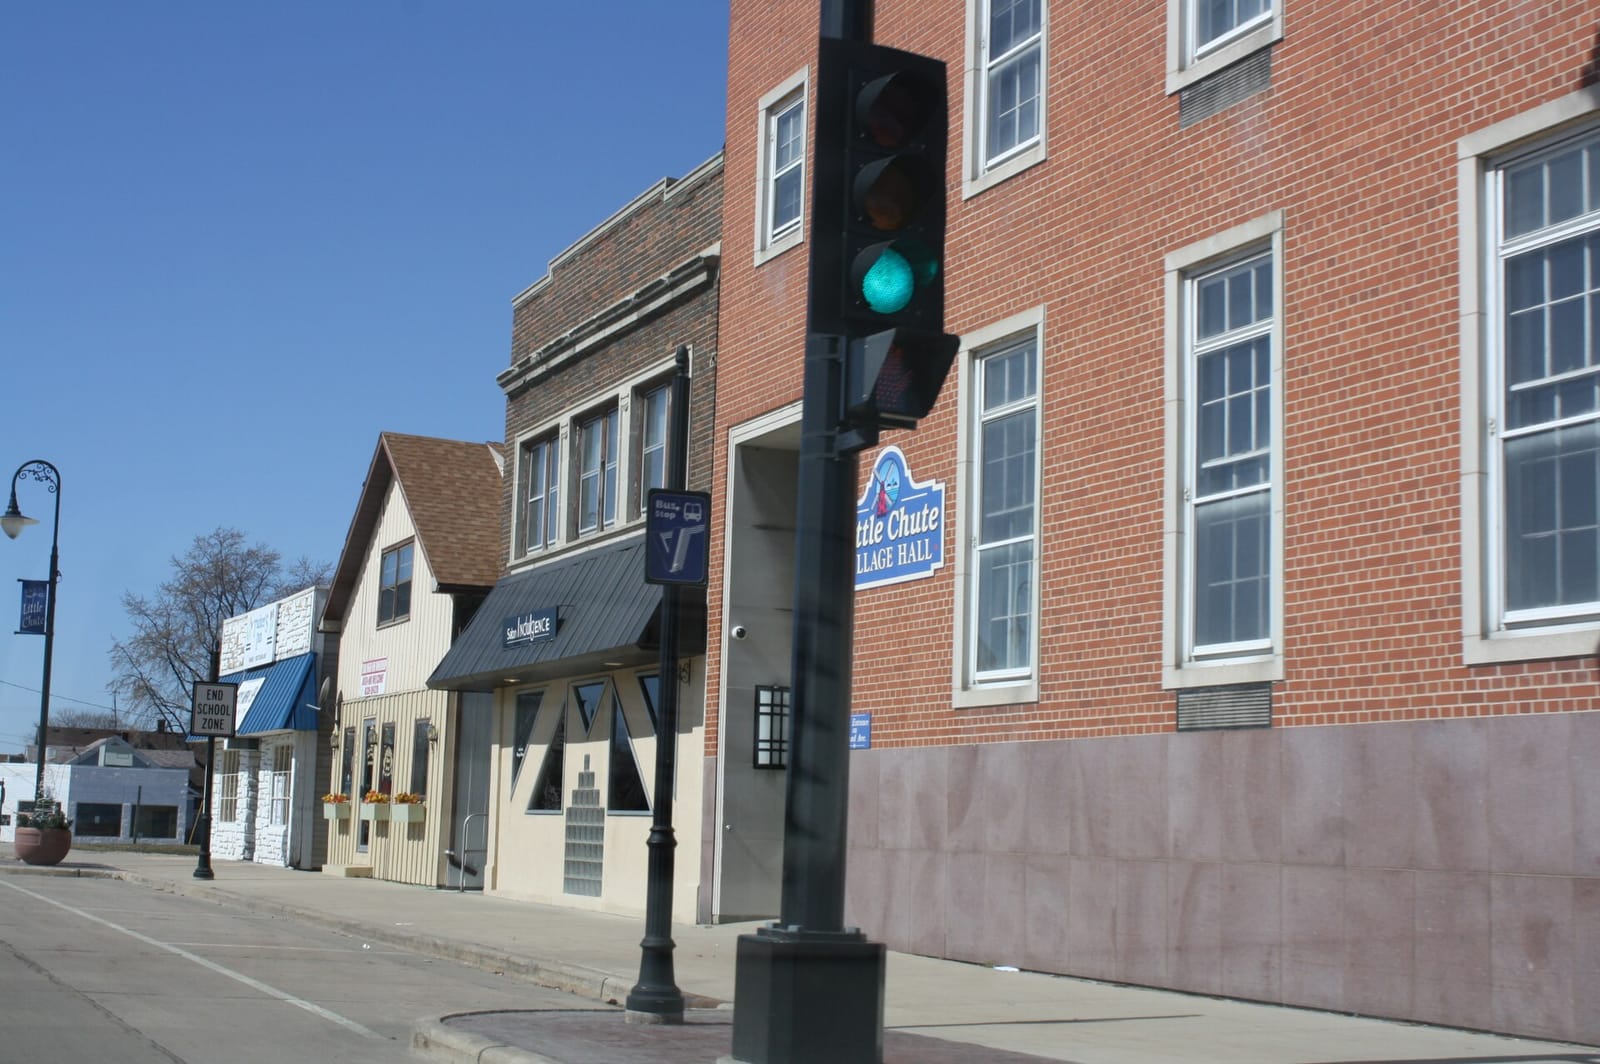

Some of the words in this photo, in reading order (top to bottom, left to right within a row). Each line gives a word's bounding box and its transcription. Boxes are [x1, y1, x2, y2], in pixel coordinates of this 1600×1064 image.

[655, 499, 677, 510] Bus
[655, 511, 676, 520] Stop
[887, 503, 939, 541] Chute
[897, 538, 933, 565] HALL
[206, 688, 224, 701] END
[197, 703, 231, 716] SCHOOL
[201, 718, 225, 730] ZONE
